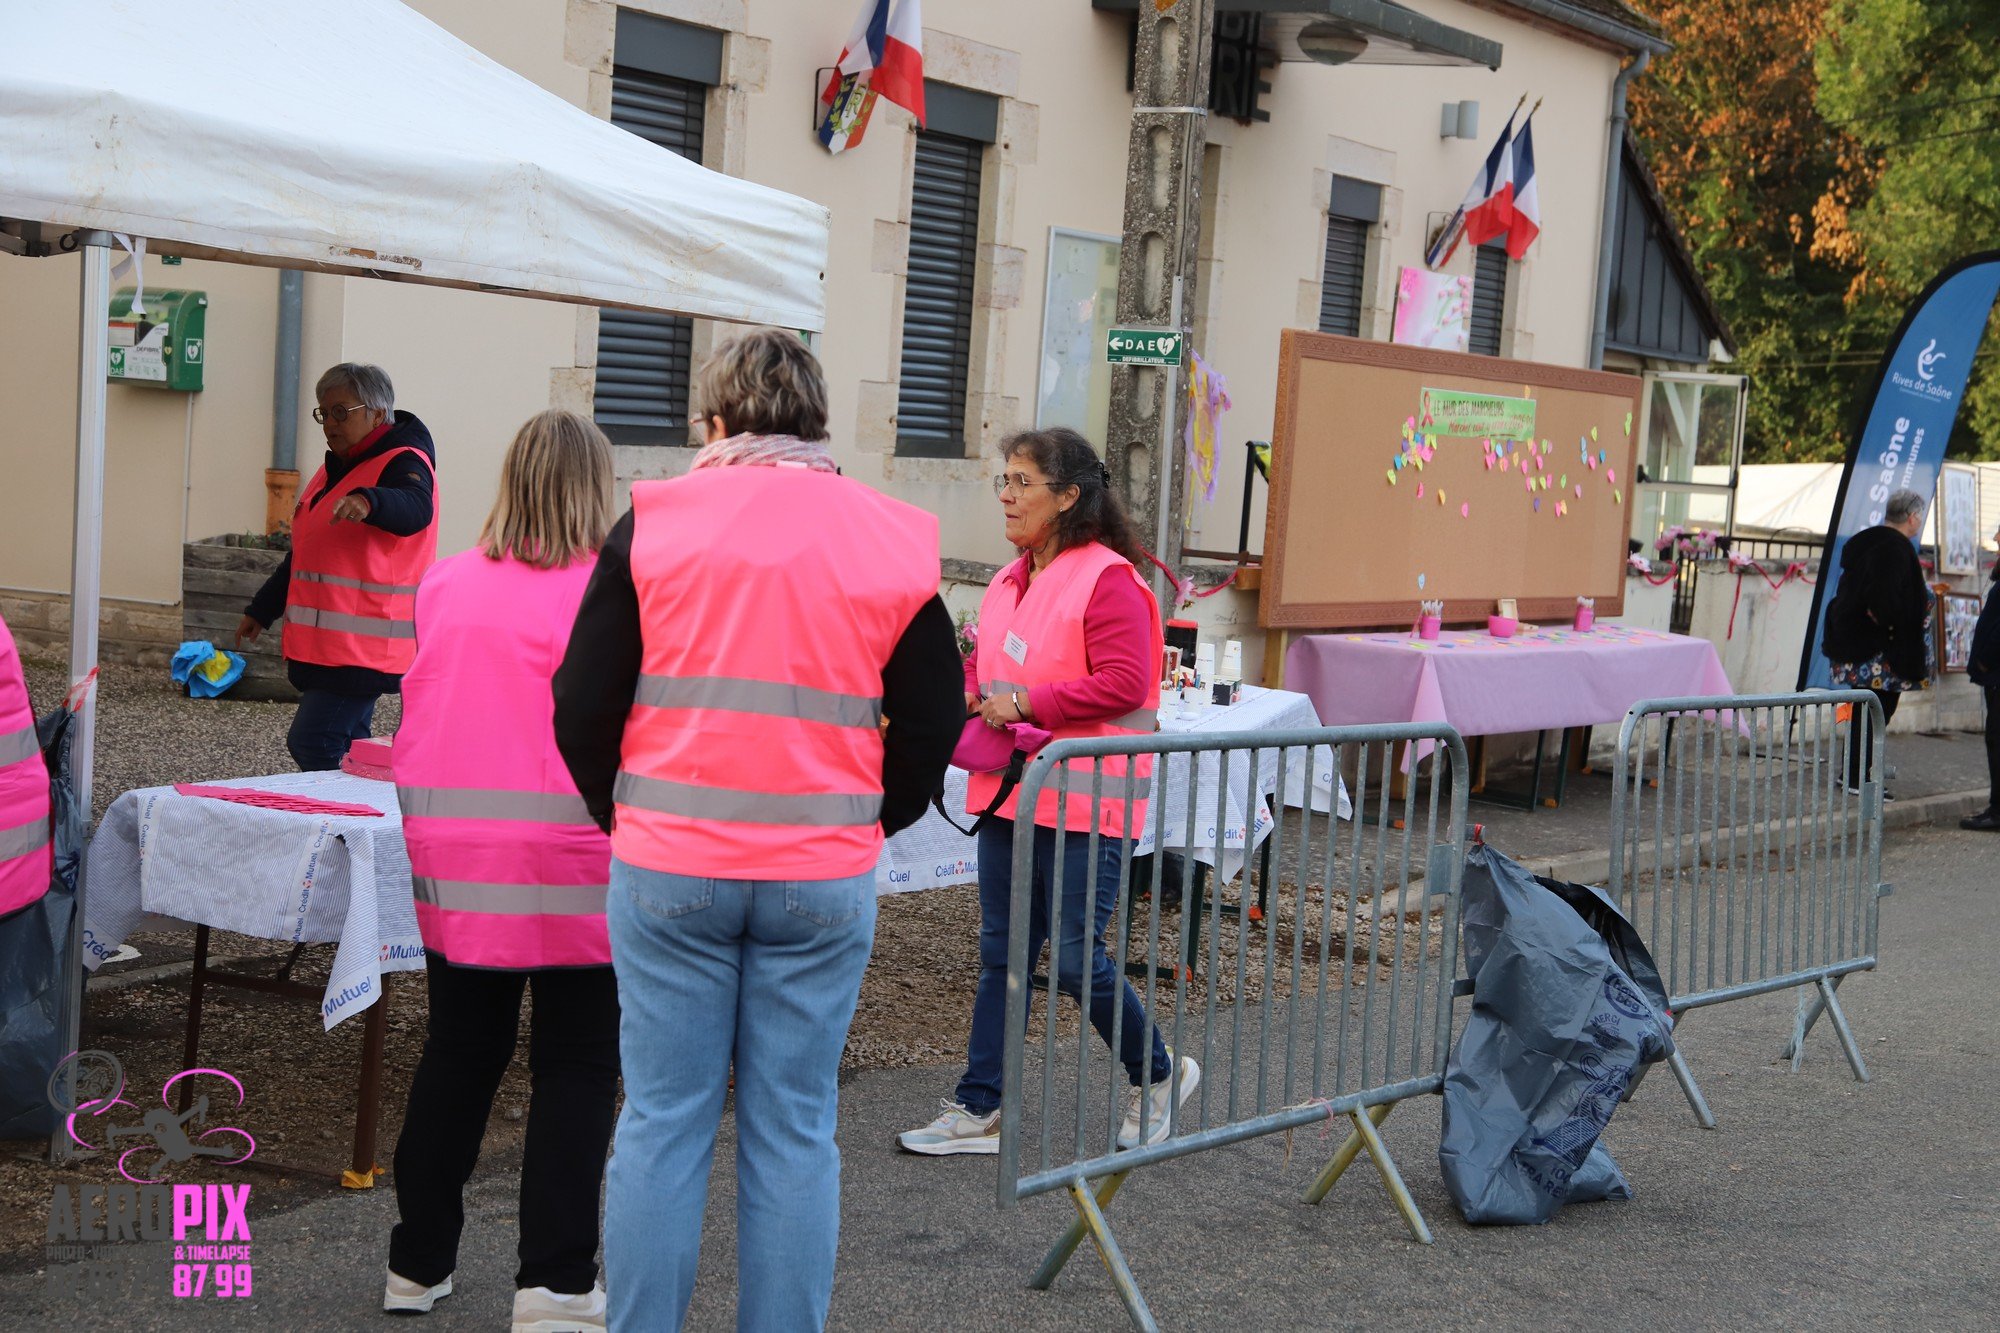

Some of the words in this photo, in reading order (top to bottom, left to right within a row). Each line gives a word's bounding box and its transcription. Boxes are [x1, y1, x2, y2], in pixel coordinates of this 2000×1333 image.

[1125, 339, 1156, 351] DAE
[111, 367, 125, 375] DAE
[1892, 371, 1913, 388] Rives
[1914, 380, 1926, 391] de
[1926, 382, 1952, 400] Saône
[1869, 416, 1910, 503] Saône
[1901, 427, 1925, 489] mmunes
[1208, 827, 1238, 840] Cdit
[305, 852, 318, 880] Mutuel
[389, 945, 426, 960] Mutue
[324, 976, 372, 1017] Mutuel
[1590, 1012, 1621, 1028] MERCI
